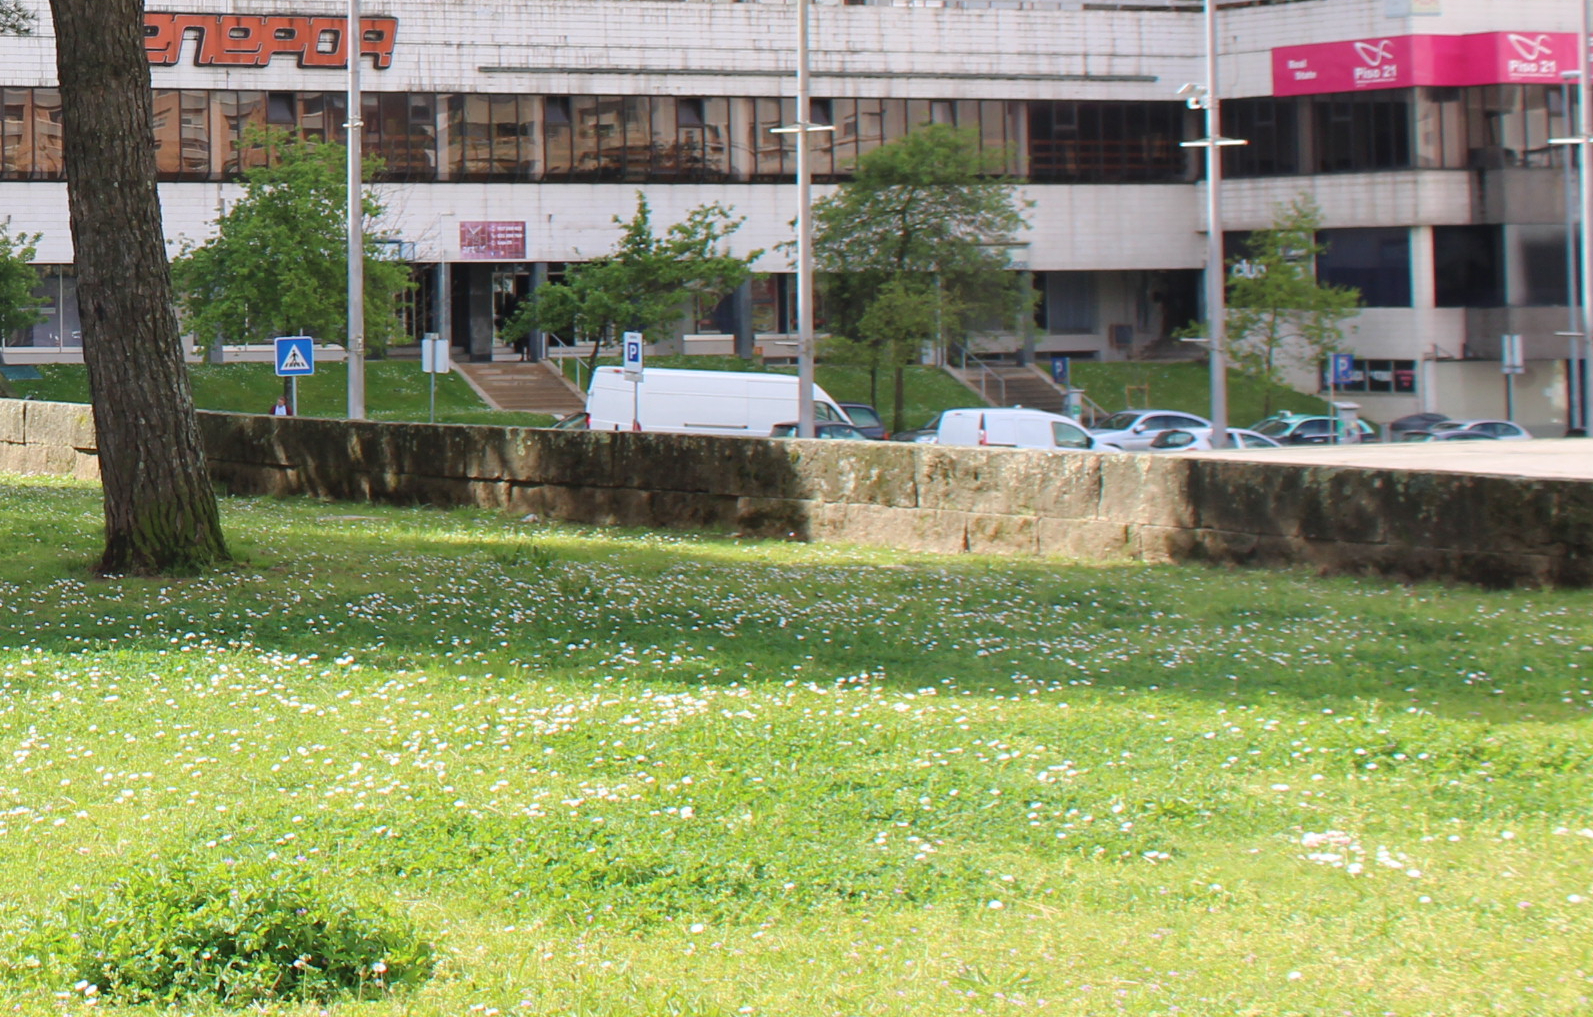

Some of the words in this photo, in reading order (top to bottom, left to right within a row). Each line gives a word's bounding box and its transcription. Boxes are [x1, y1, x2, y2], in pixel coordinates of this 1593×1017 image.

[1353, 66, 1381, 80] Piso
[1382, 64, 1398, 78] 21
[1507, 59, 1538, 73] Piso
[1539, 59, 1557, 73] 21
[629, 344, 638, 360] P
